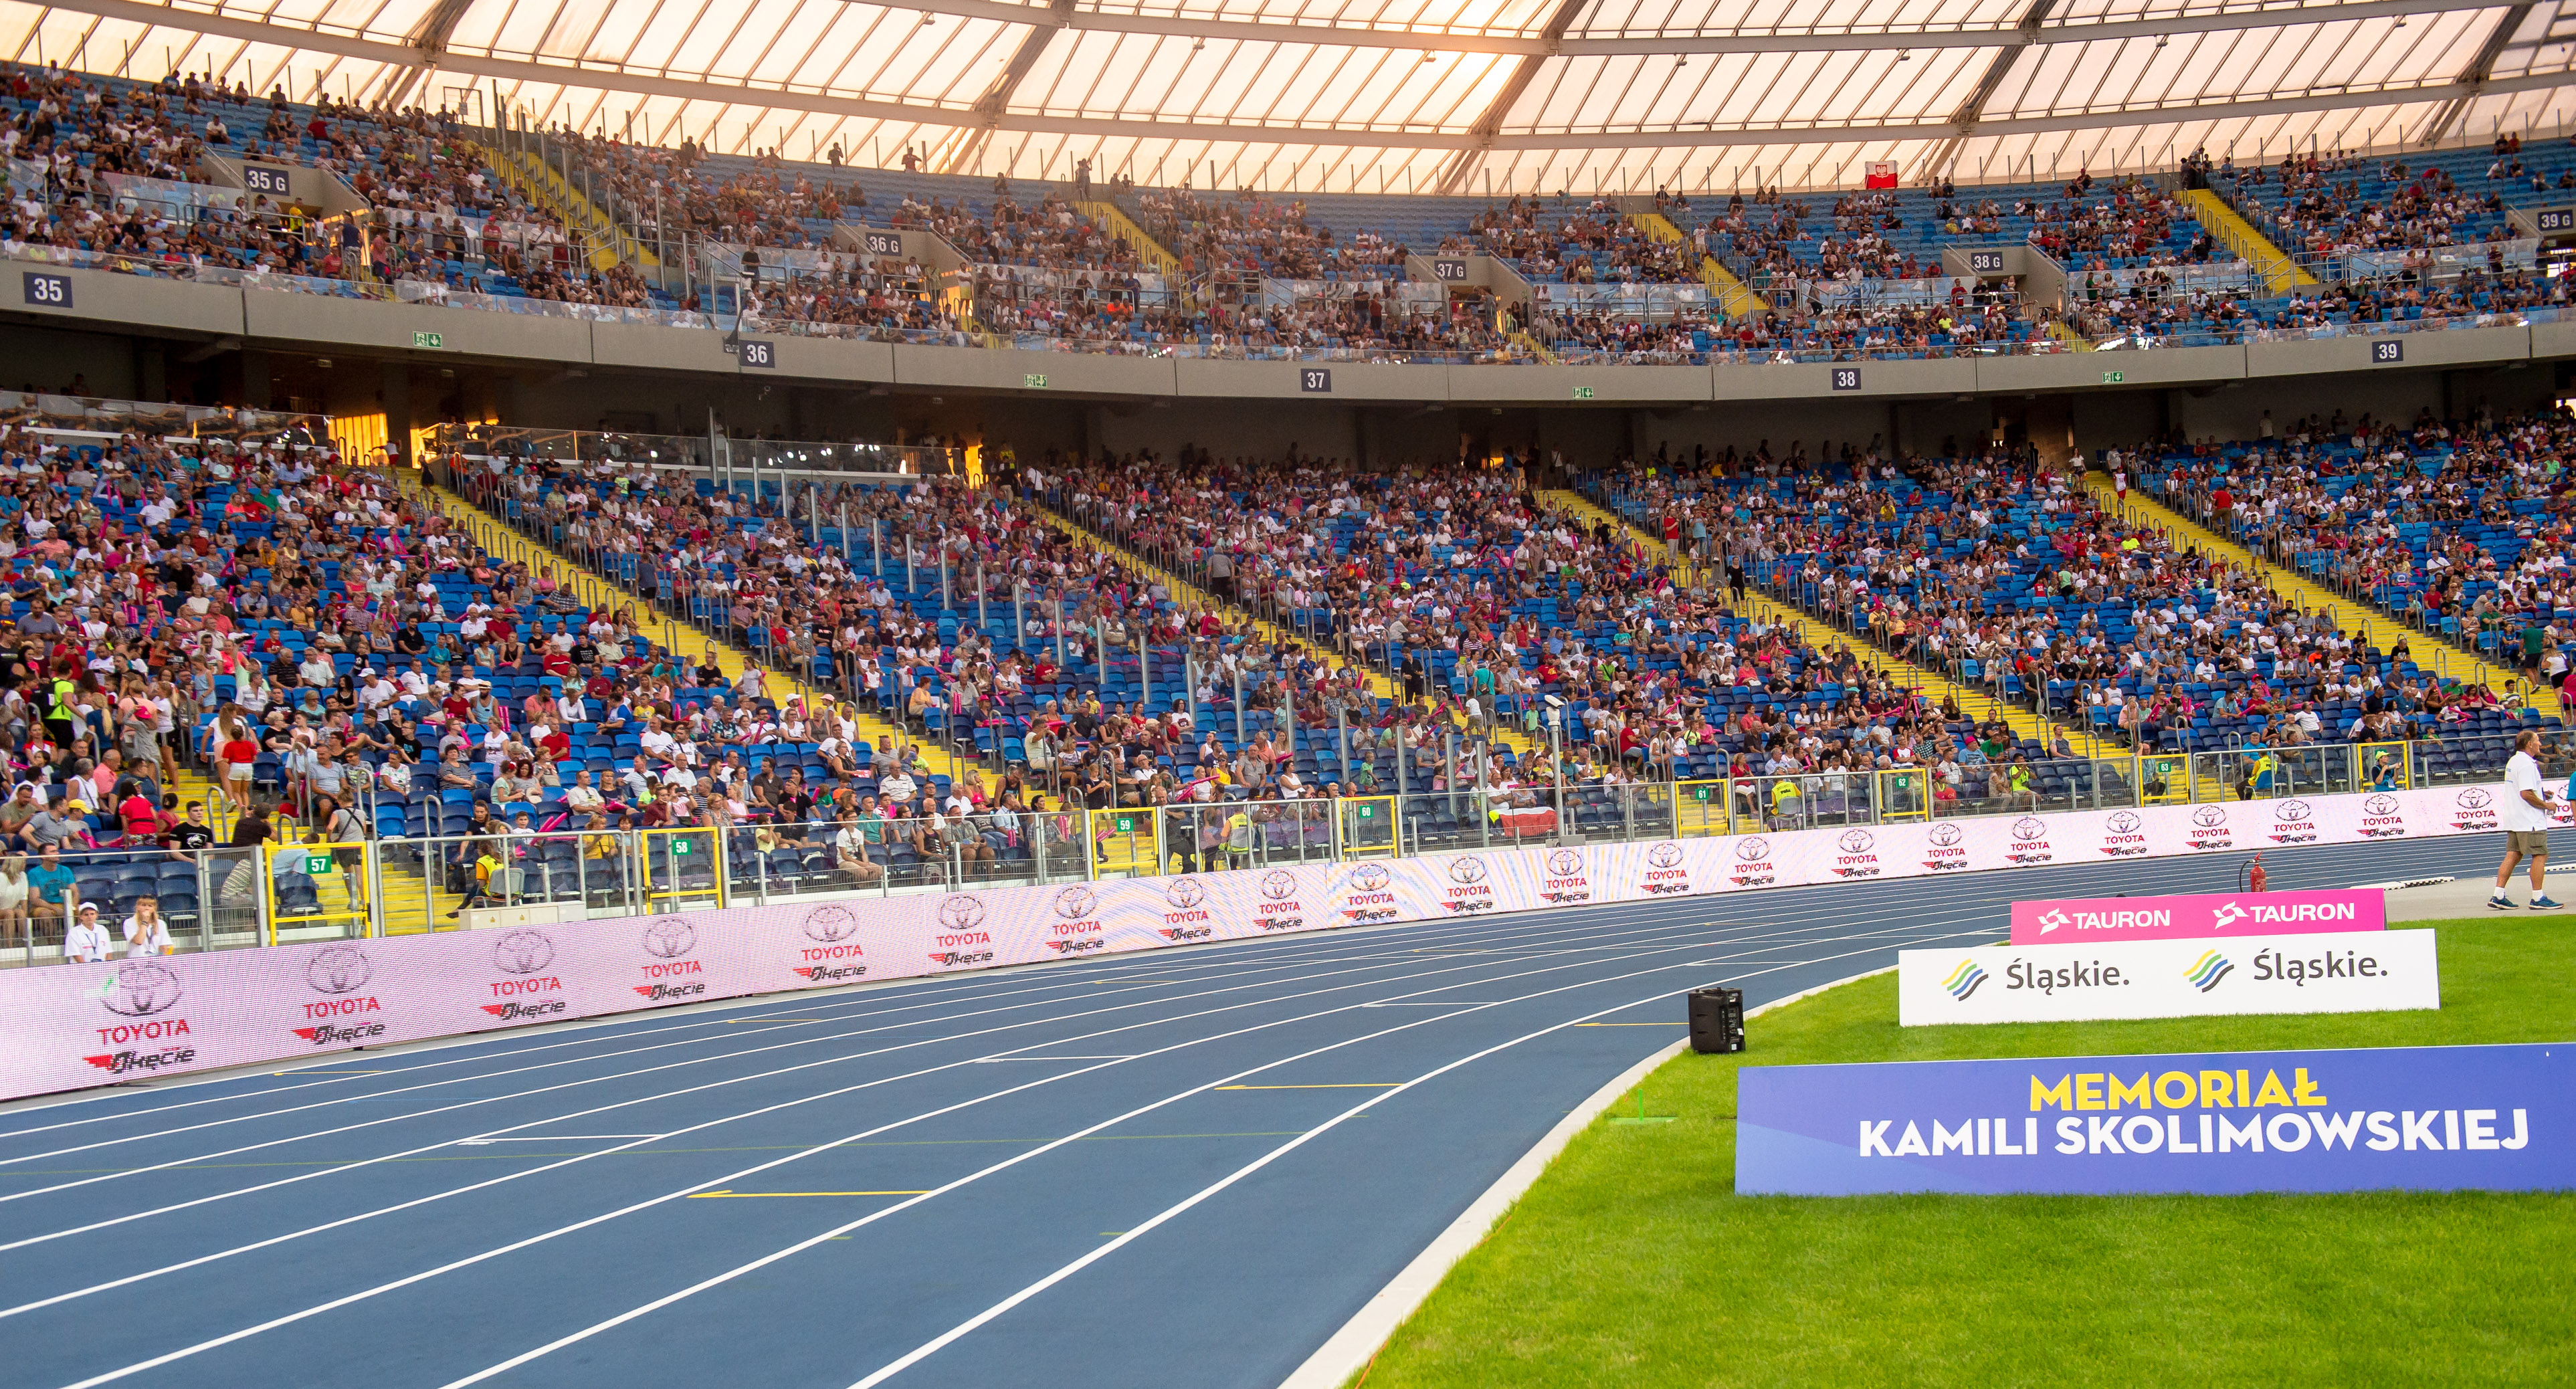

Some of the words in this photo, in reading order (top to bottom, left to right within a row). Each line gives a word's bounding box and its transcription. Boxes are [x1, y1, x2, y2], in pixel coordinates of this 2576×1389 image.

[248, 170, 270, 189] 35
[276, 177, 286, 191] G
[2541, 214, 2559, 228] 39
[2563, 215, 2570, 226] G
[869, 235, 887, 252] 36
[890, 240, 899, 253] G
[1974, 255, 1990, 269] 38
[1993, 257, 2001, 268] G
[1438, 263, 1453, 278] 37
[1456, 265, 1464, 278] G
[34, 278, 64, 302] 35
[747, 344, 768, 364] 36
[2379, 343, 2397, 359] 39
[1307, 372, 1324, 389] 37
[1838, 371, 1856, 387] 38
[2161, 763, 2169, 772] 63
[1898, 778, 1906, 786] 62
[1698, 790, 1706, 798] 61
[1361, 807, 1371, 817] 60
[2455, 809, 2496, 820] TOYOTA
[1120, 819, 1130, 831] 59
[2274, 822, 2314, 833] TOYOTA
[2362, 816, 2402, 827] TOYOTA
[2104, 834, 2145, 845] TOYOTA
[2191, 828, 2230, 839] TOYOTA
[676, 841, 688, 853] 58
[1927, 847, 1965, 858] TOYOTA
[2010, 841, 2050, 852] TOYOTA
[311, 858, 326, 871] 57
[1838, 854, 1878, 865] TOYOTA
[1735, 862, 1773, 873] TOYOTA
[1646, 869, 1687, 881] TOYOTA
[1546, 877, 1587, 889] TOYOTA
[1447, 885, 1491, 897] TOYOTA
[1347, 893, 1395, 906] TOYOTA
[1259, 901, 1300, 914] TOYOTA
[2250, 903, 2355, 923] TAURON
[1165, 910, 1209, 924] TOYOTA
[2072, 910, 2171, 930] TAURON
[1053, 920, 1102, 936] TOYOTA
[936, 932, 991, 948] TOYOTA
[801, 944, 864, 962] TOYOTA
[641, 960, 702, 979] TOYOTA
[2254, 948, 2387, 987] Śląskie.
[2006, 958, 2129, 996] Śląskie.
[491, 976, 561, 997] TOYOTA
[304, 996, 381, 1019] TOYOTA
[96, 1019, 191, 1045] TOYOTA
[2031, 1068, 2327, 1110] MEMORIAŁ
[1860, 1117, 2038, 1158] KAMILI
[2054, 1108, 2529, 1155] SKOLIMOWSKIEJ
